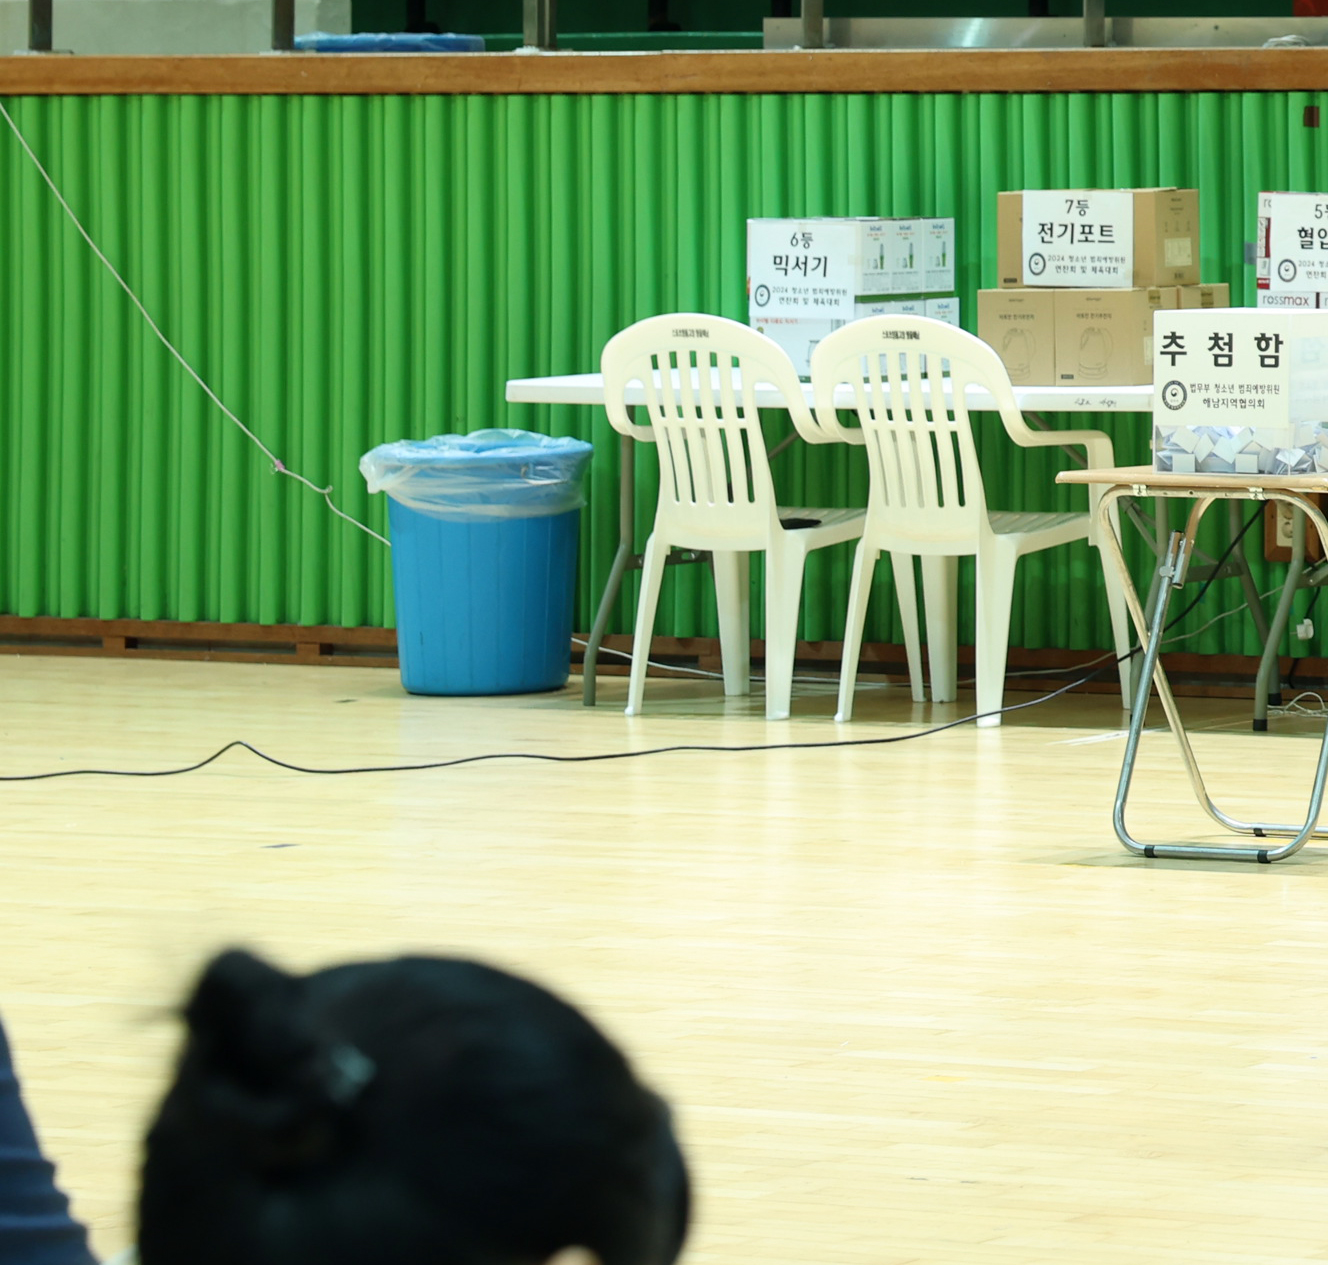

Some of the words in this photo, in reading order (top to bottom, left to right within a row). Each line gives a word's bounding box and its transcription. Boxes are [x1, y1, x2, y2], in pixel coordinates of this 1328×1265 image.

[1065, 199, 1090, 217] 7등
[1037, 222, 1116, 245] 전기포트
[790, 232, 814, 250] 6등
[1047, 255, 1065, 263] 2024
[1068, 255, 1087, 265] 청소년
[1298, 260, 1315, 268] 2024
[772, 254, 828, 278] 믹서기
[1080, 266, 1087, 274] 및
[1091, 265, 1118, 275] 체육대회
[772, 286, 788, 294] 2024
[791, 286, 810, 295] 청소년
[803, 297, 810, 306] 및
[813, 297, 840, 307] 체육대회
[1262, 294, 1310, 307] rossmax
[1190, 383, 1210, 394] 법무부
[1214, 383, 1235, 395] 청소년
[1238, 383, 1280, 395] 범죄예방위원
[1202, 398, 1265, 409] 해남지역협의회
